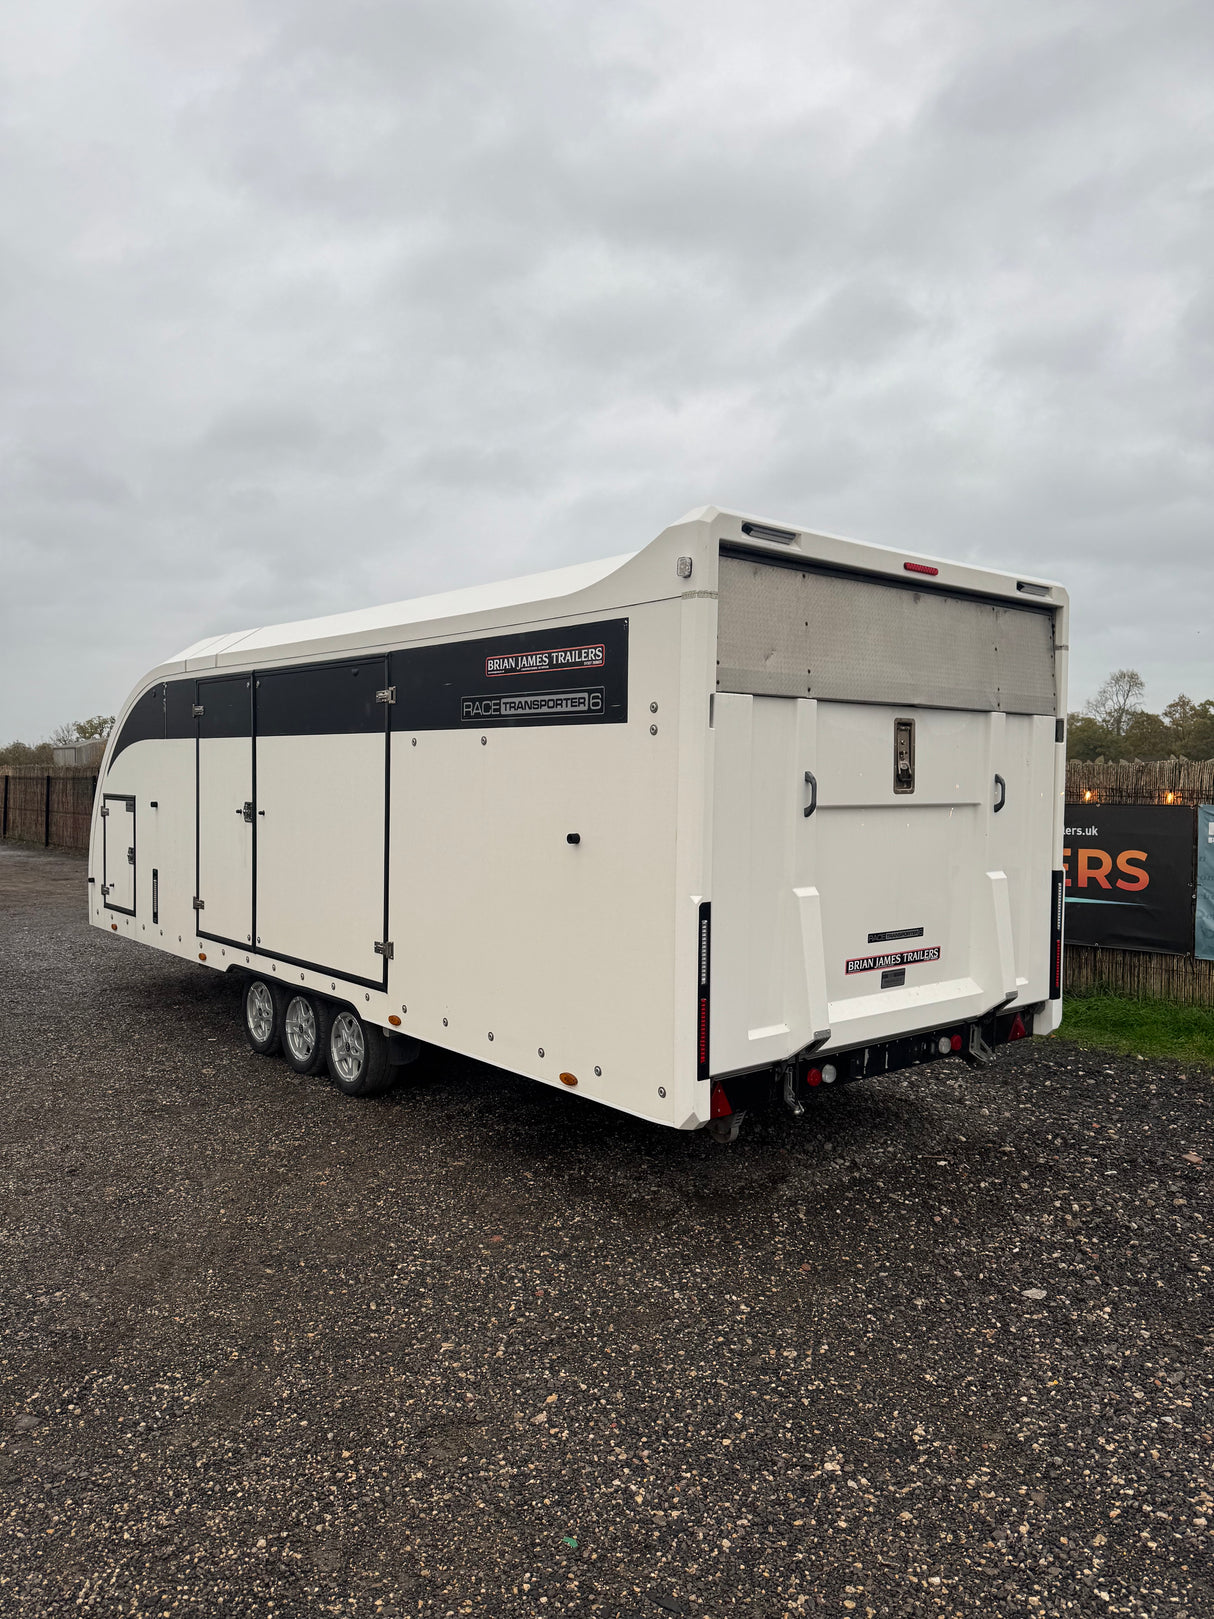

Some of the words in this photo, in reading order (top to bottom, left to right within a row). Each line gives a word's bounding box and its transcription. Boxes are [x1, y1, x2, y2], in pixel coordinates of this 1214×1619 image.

[488, 658, 515, 670] BRIAN
[516, 654, 549, 669] JAMES
[552, 648, 602, 664] TRAILERS
[463, 700, 500, 716] RACE
[503, 697, 586, 711] TRANSPORTER
[590, 693, 602, 710] 6
[1064, 826, 1098, 836] ers.uk
[848, 958, 874, 970] BRIAN
[874, 955, 901, 968] JAMES
[903, 948, 939, 961] TRAILERS
